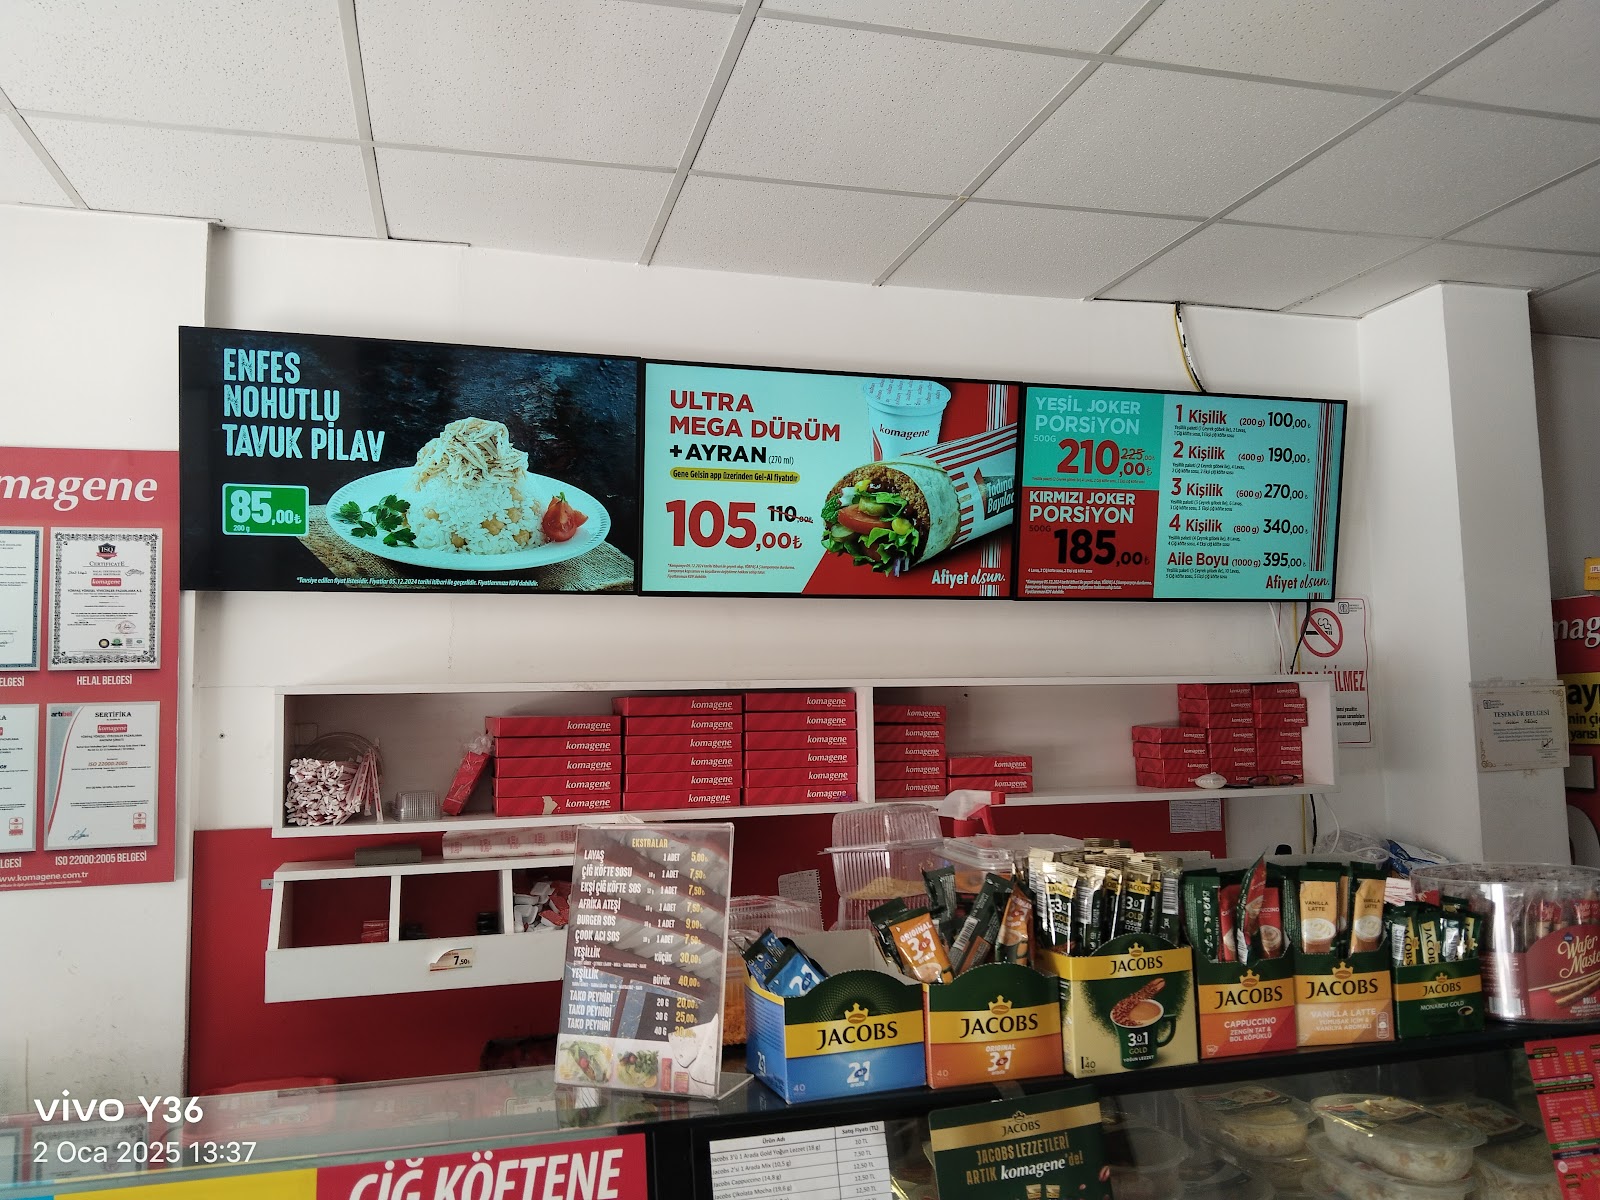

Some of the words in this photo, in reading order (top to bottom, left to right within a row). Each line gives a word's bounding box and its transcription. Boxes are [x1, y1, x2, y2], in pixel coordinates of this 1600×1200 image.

[223, 348, 301, 384] ENFES
[223, 384, 341, 421] NOHUTLU
[670, 390, 754, 412] ULTRA
[1035, 395, 1083, 413] YEŞİL
[1087, 399, 1141, 415] JOKER
[1176, 404, 1183, 423] 1
[1189, 409, 1228, 426] Kişilik
[670, 416, 743, 437] MEGA
[751, 416, 841, 442] DÜRÜM
[879, 423, 930, 440] komagene
[222, 424, 304, 459] TAVUK
[311, 422, 386, 462] PİLAV
[1033, 434, 1057, 443] 500G
[1173, 440, 1183, 458] 2
[1188, 445, 1226, 461] Kişilik
[673, 469, 688, 478] Gene
[690, 470, 709, 480] Gelsin
[710, 472, 722, 482] app
[723, 472, 753, 480] üzerinden
[774, 473, 798, 483] fiyatıdır
[1171, 477, 1182, 496] 3
[1186, 482, 1223, 498] Kişilik
[1029, 491, 1084, 504] KIRMIZI
[1087, 492, 1136, 505] JOKER
[1169, 514, 1180, 532] 4
[1185, 519, 1223, 534] Kişilik
[1167, 551, 1193, 566] Aile
[1196, 553, 1229, 569] Boyu
[931, 568, 969, 588] Afiyet
[1265, 574, 1298, 592] Afiyet
[76, 676, 101, 686] HELAL
[102, 673, 133, 686] BELGESİ
[691, 700, 733, 712] komagene
[807, 697, 847, 709] komagene
[567, 721, 612, 735] komagene
[691, 720, 733, 732] komagene
[806, 716, 848, 729] komagene
[631, 838, 668, 849] EKSTRALAR
[55, 856, 69, 866] ISO
[69, 853, 116, 865] 22000:2005
[117, 850, 147, 862] BELGESİ
[584, 849, 605, 864] LAVAŞ
[667, 854, 680, 863] ADET
[582, 864, 593, 880] ÇİĞ
[594, 864, 615, 878] KÖFTE
[615, 867, 633, 878] SOSU
[580, 880, 595, 896] EKŞİ
[596, 880, 607, 896] ÇİĞ
[607, 881, 627, 894] KÖFTE
[629, 883, 641, 894] SOS
[578, 897, 602, 910] AFRİKA
[602, 898, 621, 914] ATEŞİ
[577, 914, 602, 926] BURGER
[603, 915, 616, 926] SOS
[594, 930, 606, 942] ACI
[607, 930, 620, 943] SOS
[900, 921, 932, 943] ORIGINAL
[574, 945, 601, 961] YEŞİLLİK
[654, 951, 672, 965] KÜÇÜK
[1558, 935, 1598, 961] Wafer
[1111, 956, 1163, 975] JACOBS
[572, 967, 599, 982] YEŞİLLİK
[652, 974, 671, 986] BÜYÜK
[1306, 979, 1379, 1000] JACOBS
[1423, 981, 1462, 997] JACOBS
[570, 990, 587, 1002] TAKO
[587, 990, 614, 1003] PEYNİRİ
[656, 997, 665, 1008] 20
[1215, 986, 1283, 1010] JACOBS
[568, 1004, 585, 1016] TAKO
[586, 1004, 612, 1018] PEYNİRİ
[655, 1011, 663, 1021] 30
[1311, 1010, 1347, 1022] VANILLA
[1351, 1008, 1377, 1019] LATTE
[1420, 1003, 1449, 1014] MONARCH
[1449, 1000, 1465, 1011] GOLD
[568, 1018, 584, 1030] TAKO
[585, 1018, 611, 1031] PEYNİRİ
[960, 1014, 1038, 1038] JACOBS
[1224, 1017, 1276, 1029] CAPPUCCINO
[815, 1021, 898, 1051] JACOBS
[1229, 1037, 1241, 1047] BOL
[1243, 1033, 1272, 1045] KÖPÜKLÜ
[1230, 1028, 1253, 1039] ZENGİN
[1254, 1027, 1265, 1036] TAT
[986, 1043, 1016, 1054] ORIGINAL
[1128, 1045, 1148, 1055] GOLD
[1001, 1119, 1041, 1137] JACOBS
[976, 1145, 1014, 1166] JACOBS
[1015, 1132, 1070, 1158] LEZZETLERİ
[731, 1177, 762, 1187] Cappuccino
[966, 1167, 997, 1186] ARTIK
[733, 1189, 753, 1199] Çikolata
